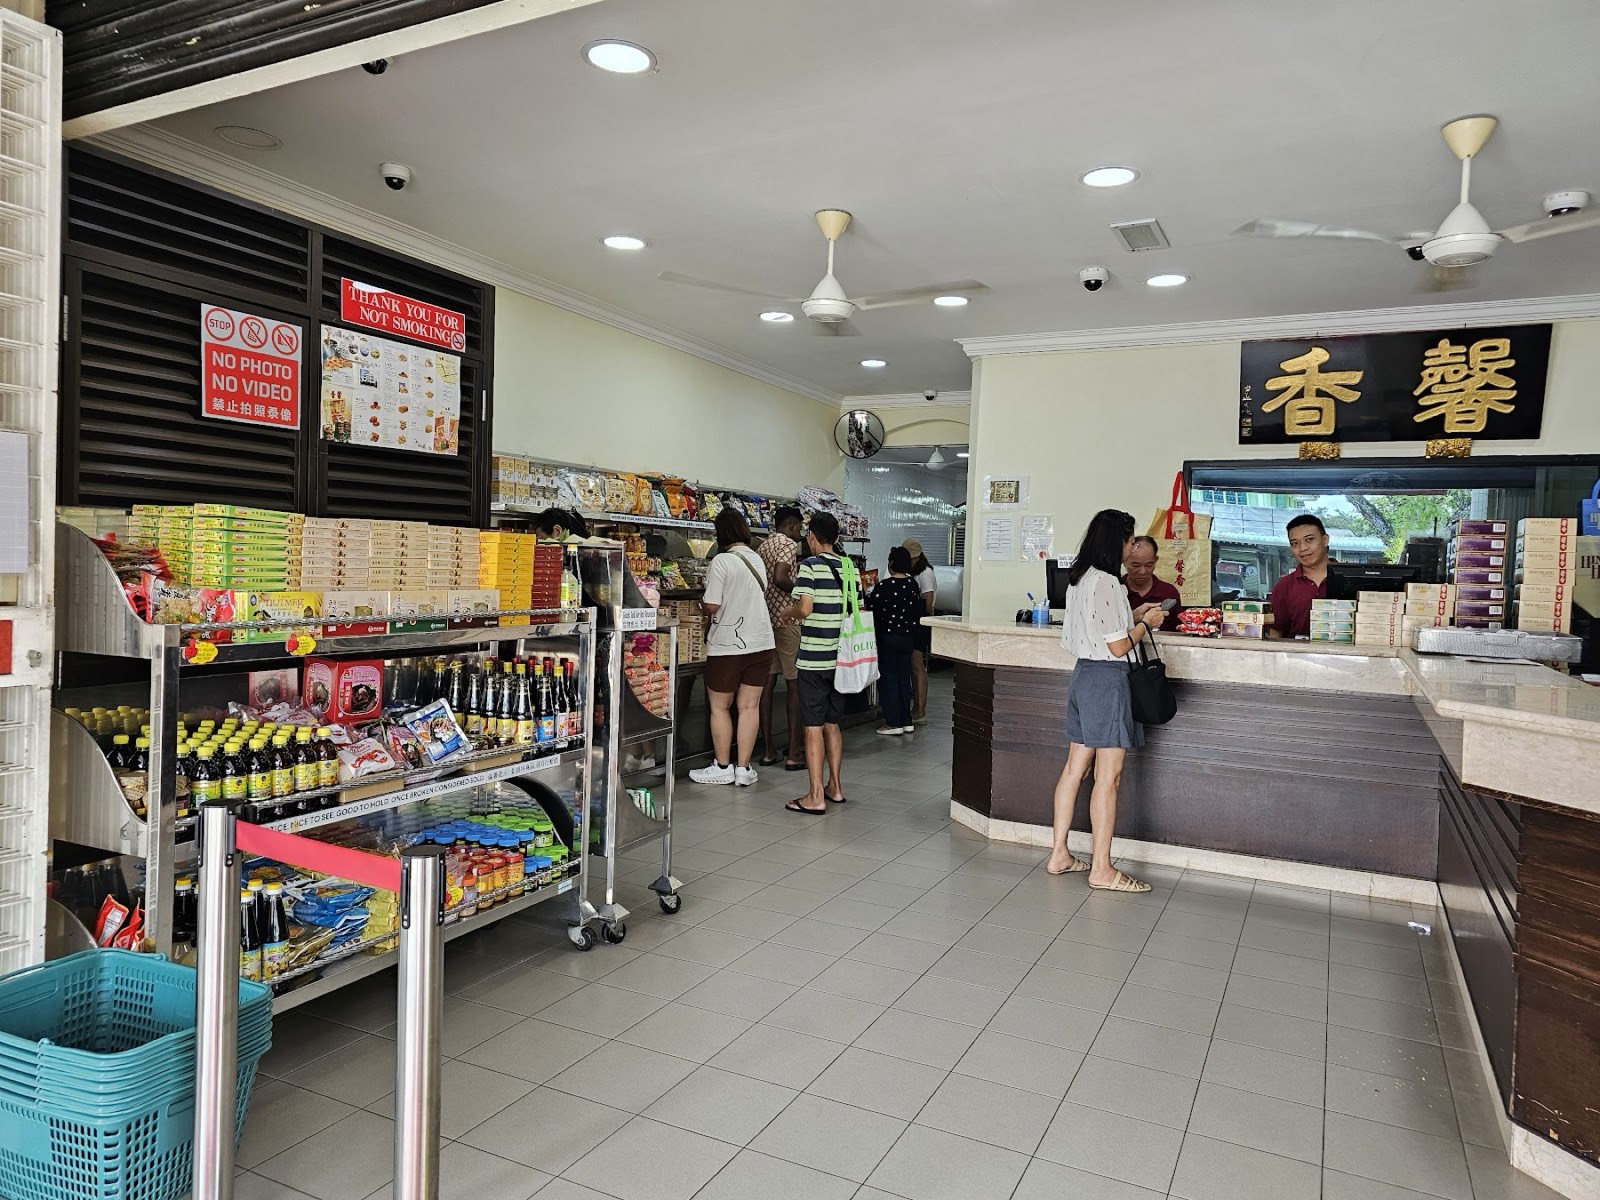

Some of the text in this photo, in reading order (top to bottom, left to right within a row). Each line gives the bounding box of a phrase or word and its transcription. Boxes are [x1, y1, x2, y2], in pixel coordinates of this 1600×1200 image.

[208, 317, 231, 331] STOP
[348, 286, 459, 330] THANK YOU FOR
[359, 306, 451, 344] NOT SMOKING
[212, 350, 292, 380] NO PHOTO
[212, 372, 292, 402] NO VIDEO
[310, 815, 320, 825] TO
[336, 805, 359, 818] GOOD
[360, 802, 370, 811] TO
[391, 791, 409, 803] ONCE
[410, 787, 434, 800] BROKEN
[434, 778, 469, 793] CONSIDERED
